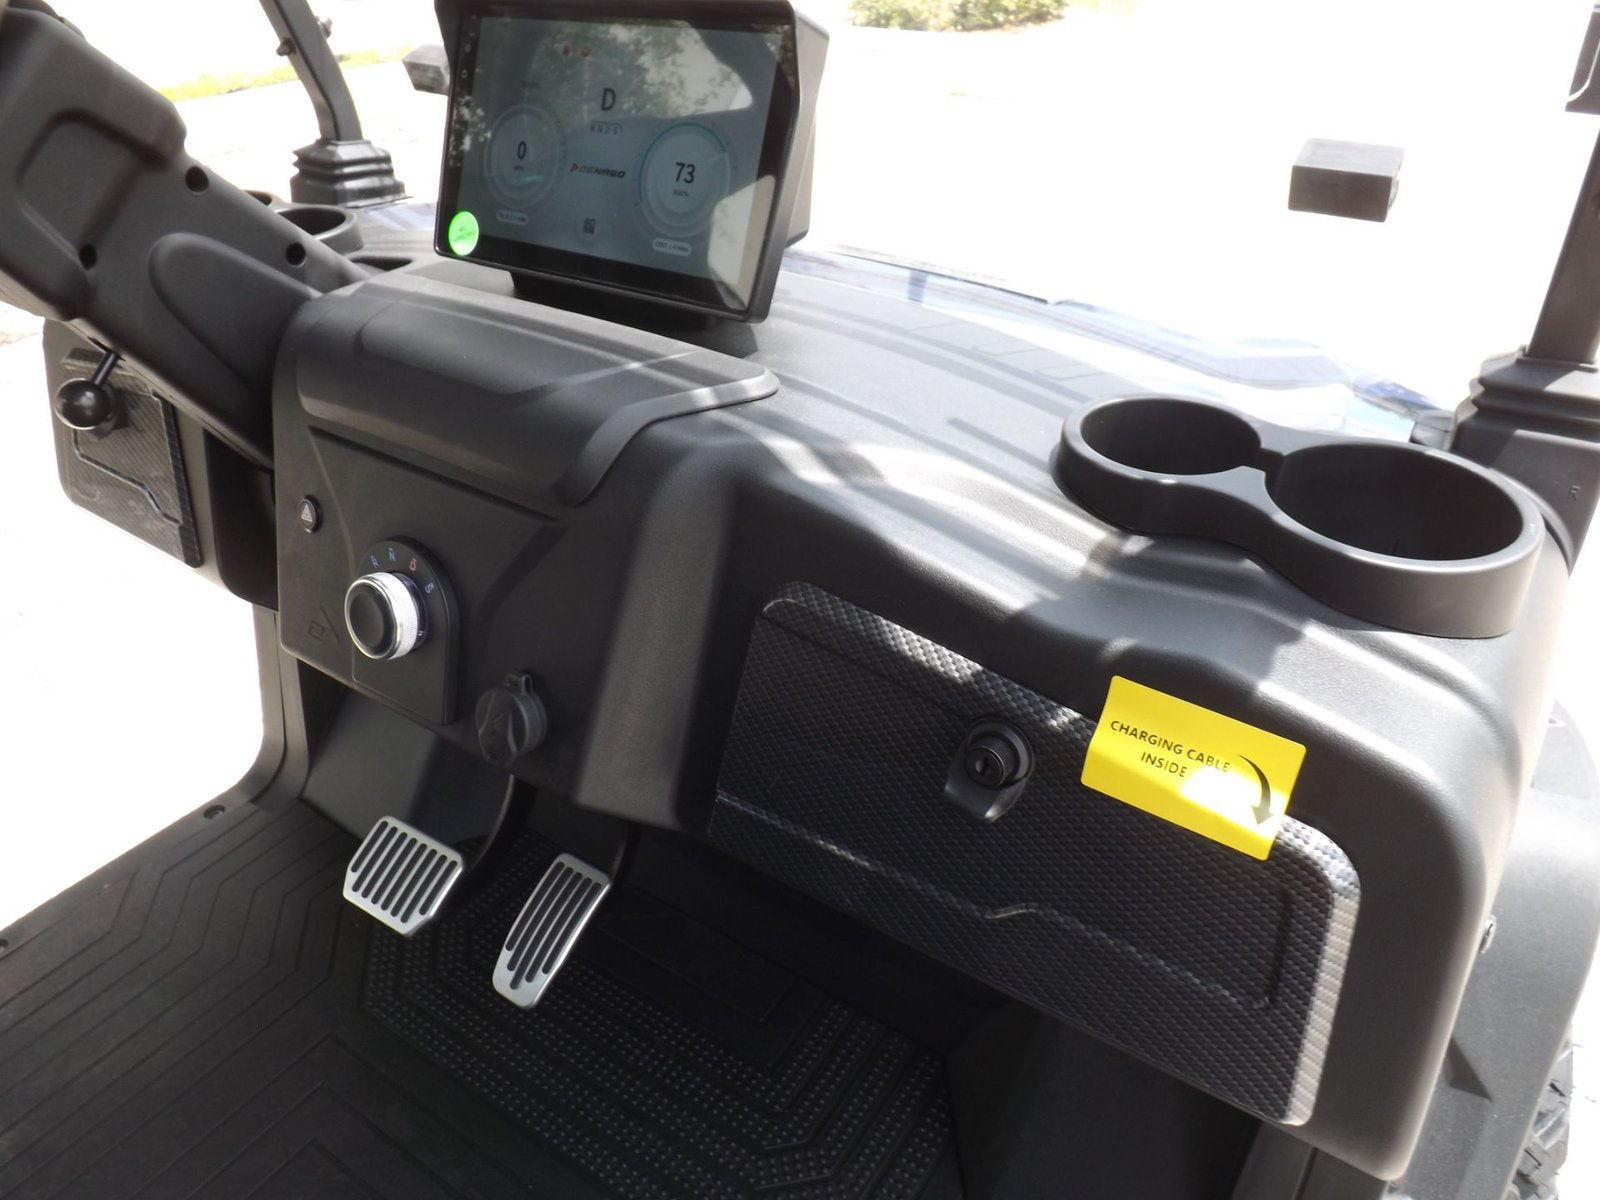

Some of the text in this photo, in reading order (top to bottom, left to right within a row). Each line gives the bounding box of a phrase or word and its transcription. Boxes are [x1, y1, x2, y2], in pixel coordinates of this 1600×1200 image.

[601, 86, 616, 111] D
[517, 141, 526, 159] 0
[675, 162, 695, 184] 73
[1110, 720, 1231, 773] CHARGING CABLE
[1140, 751, 1188, 777] INSIDE
